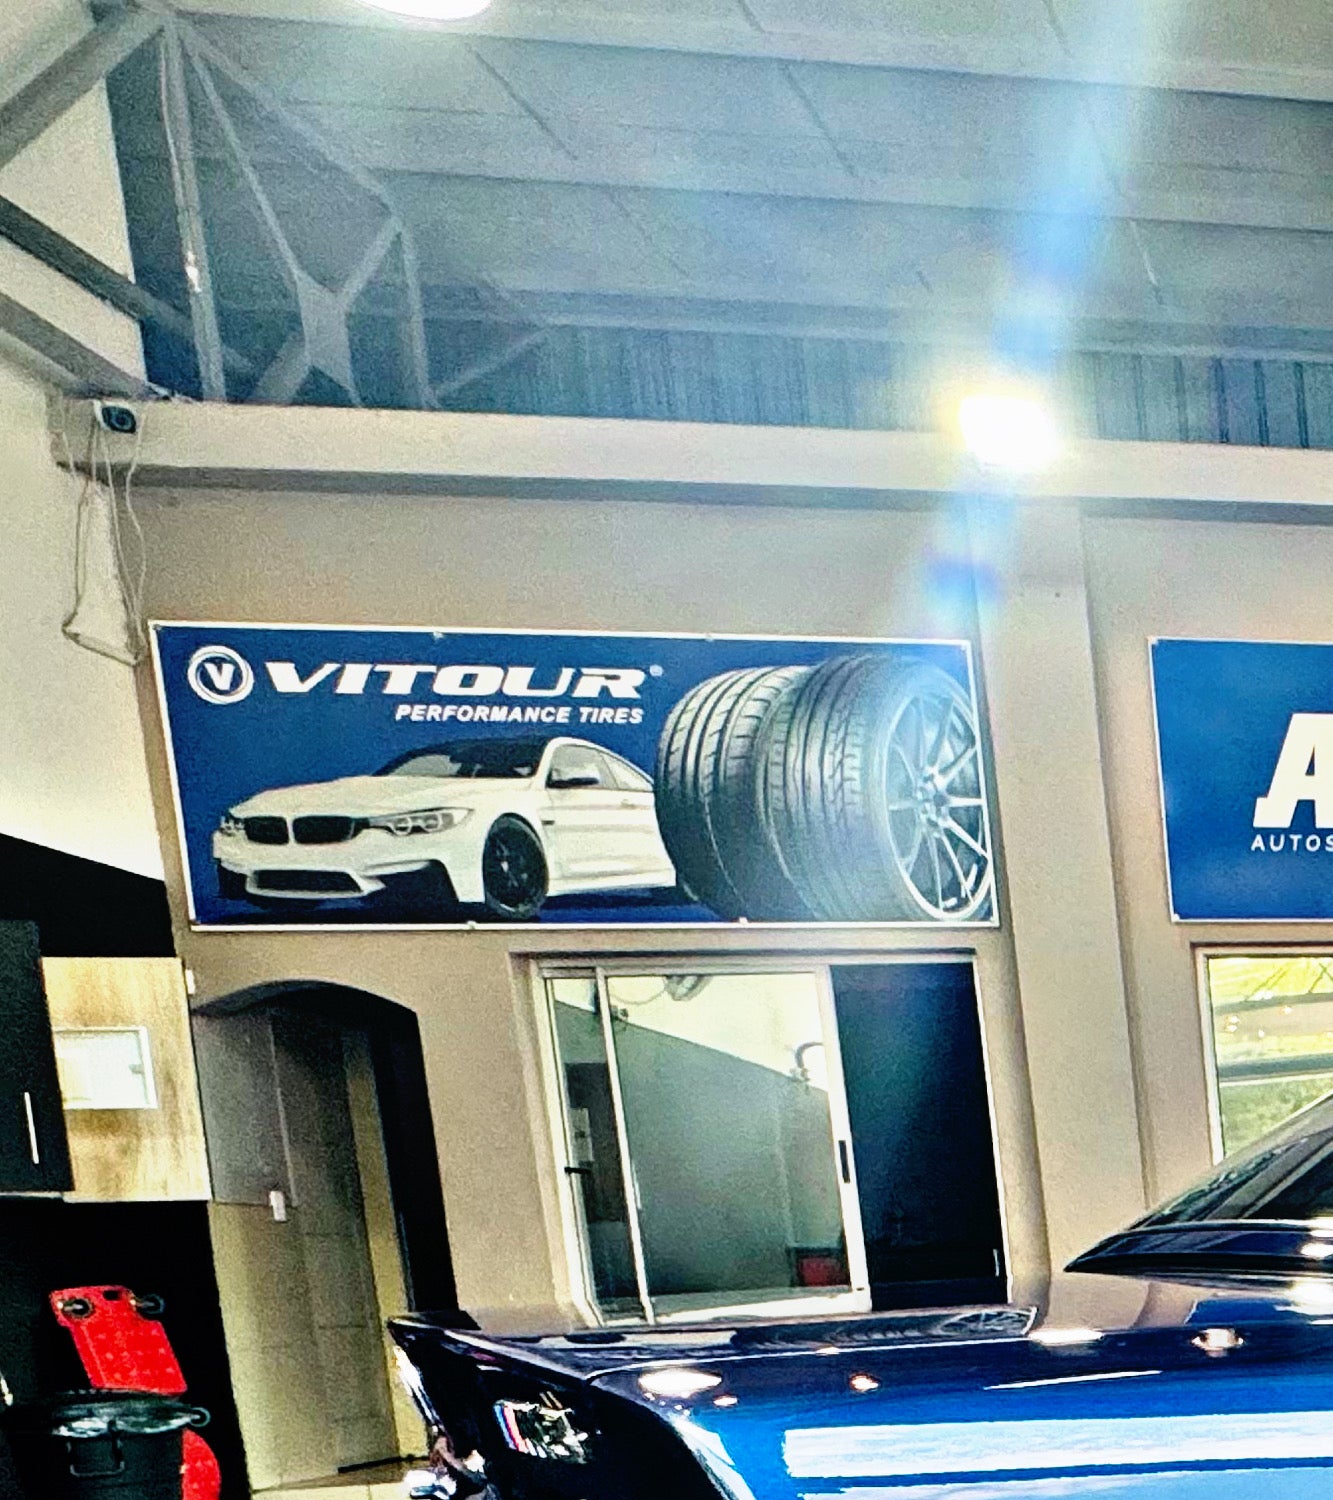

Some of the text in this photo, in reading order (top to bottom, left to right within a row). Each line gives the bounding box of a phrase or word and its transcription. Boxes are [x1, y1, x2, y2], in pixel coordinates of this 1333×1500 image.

[264, 661, 648, 699] VITOUR
[394, 703, 643, 725] PERFORMANCE TIRES
